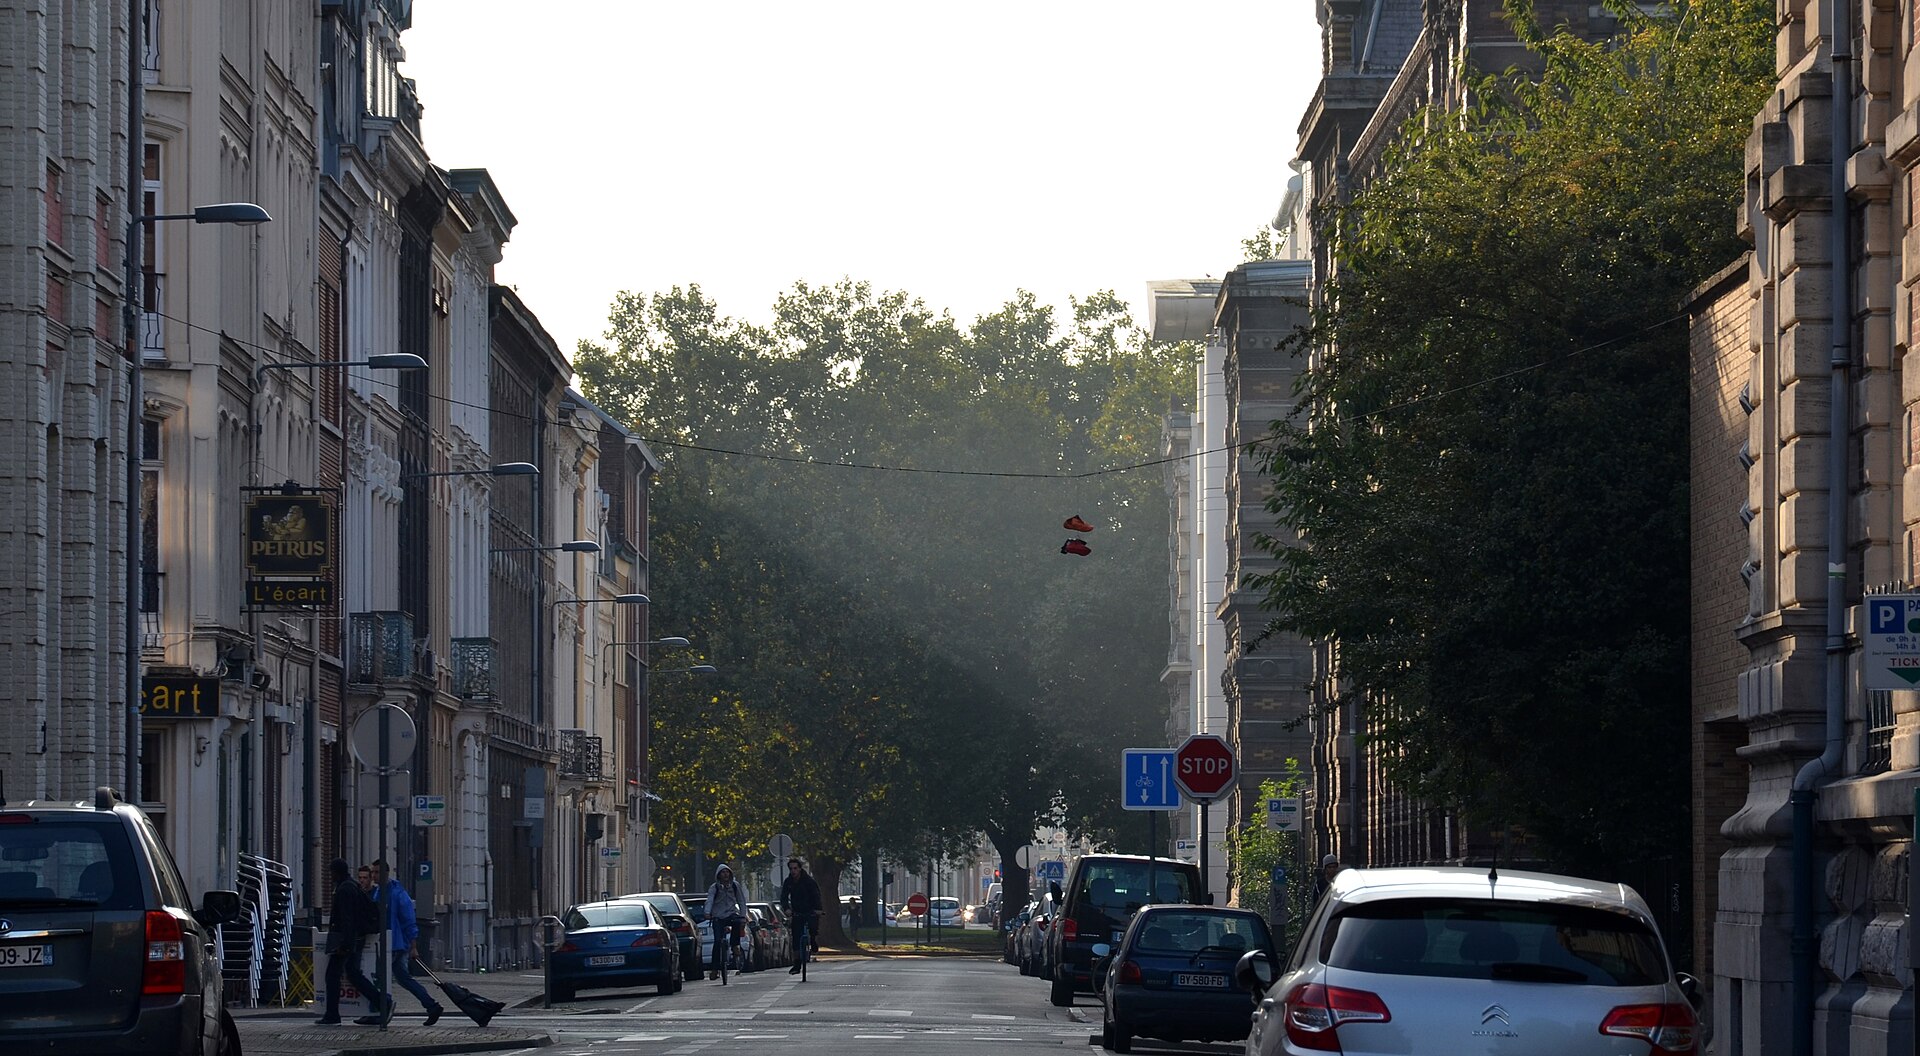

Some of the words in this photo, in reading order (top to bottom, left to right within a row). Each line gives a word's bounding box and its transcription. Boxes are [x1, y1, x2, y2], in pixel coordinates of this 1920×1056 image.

[251, 540, 326, 559] PETRUS
[254, 586, 327, 602] L'écart
[1879, 605, 1896, 629] P
[1889, 657, 1919, 667] TICK
[1182, 757, 1229, 774] STOP
[419, 864, 429, 876] P
